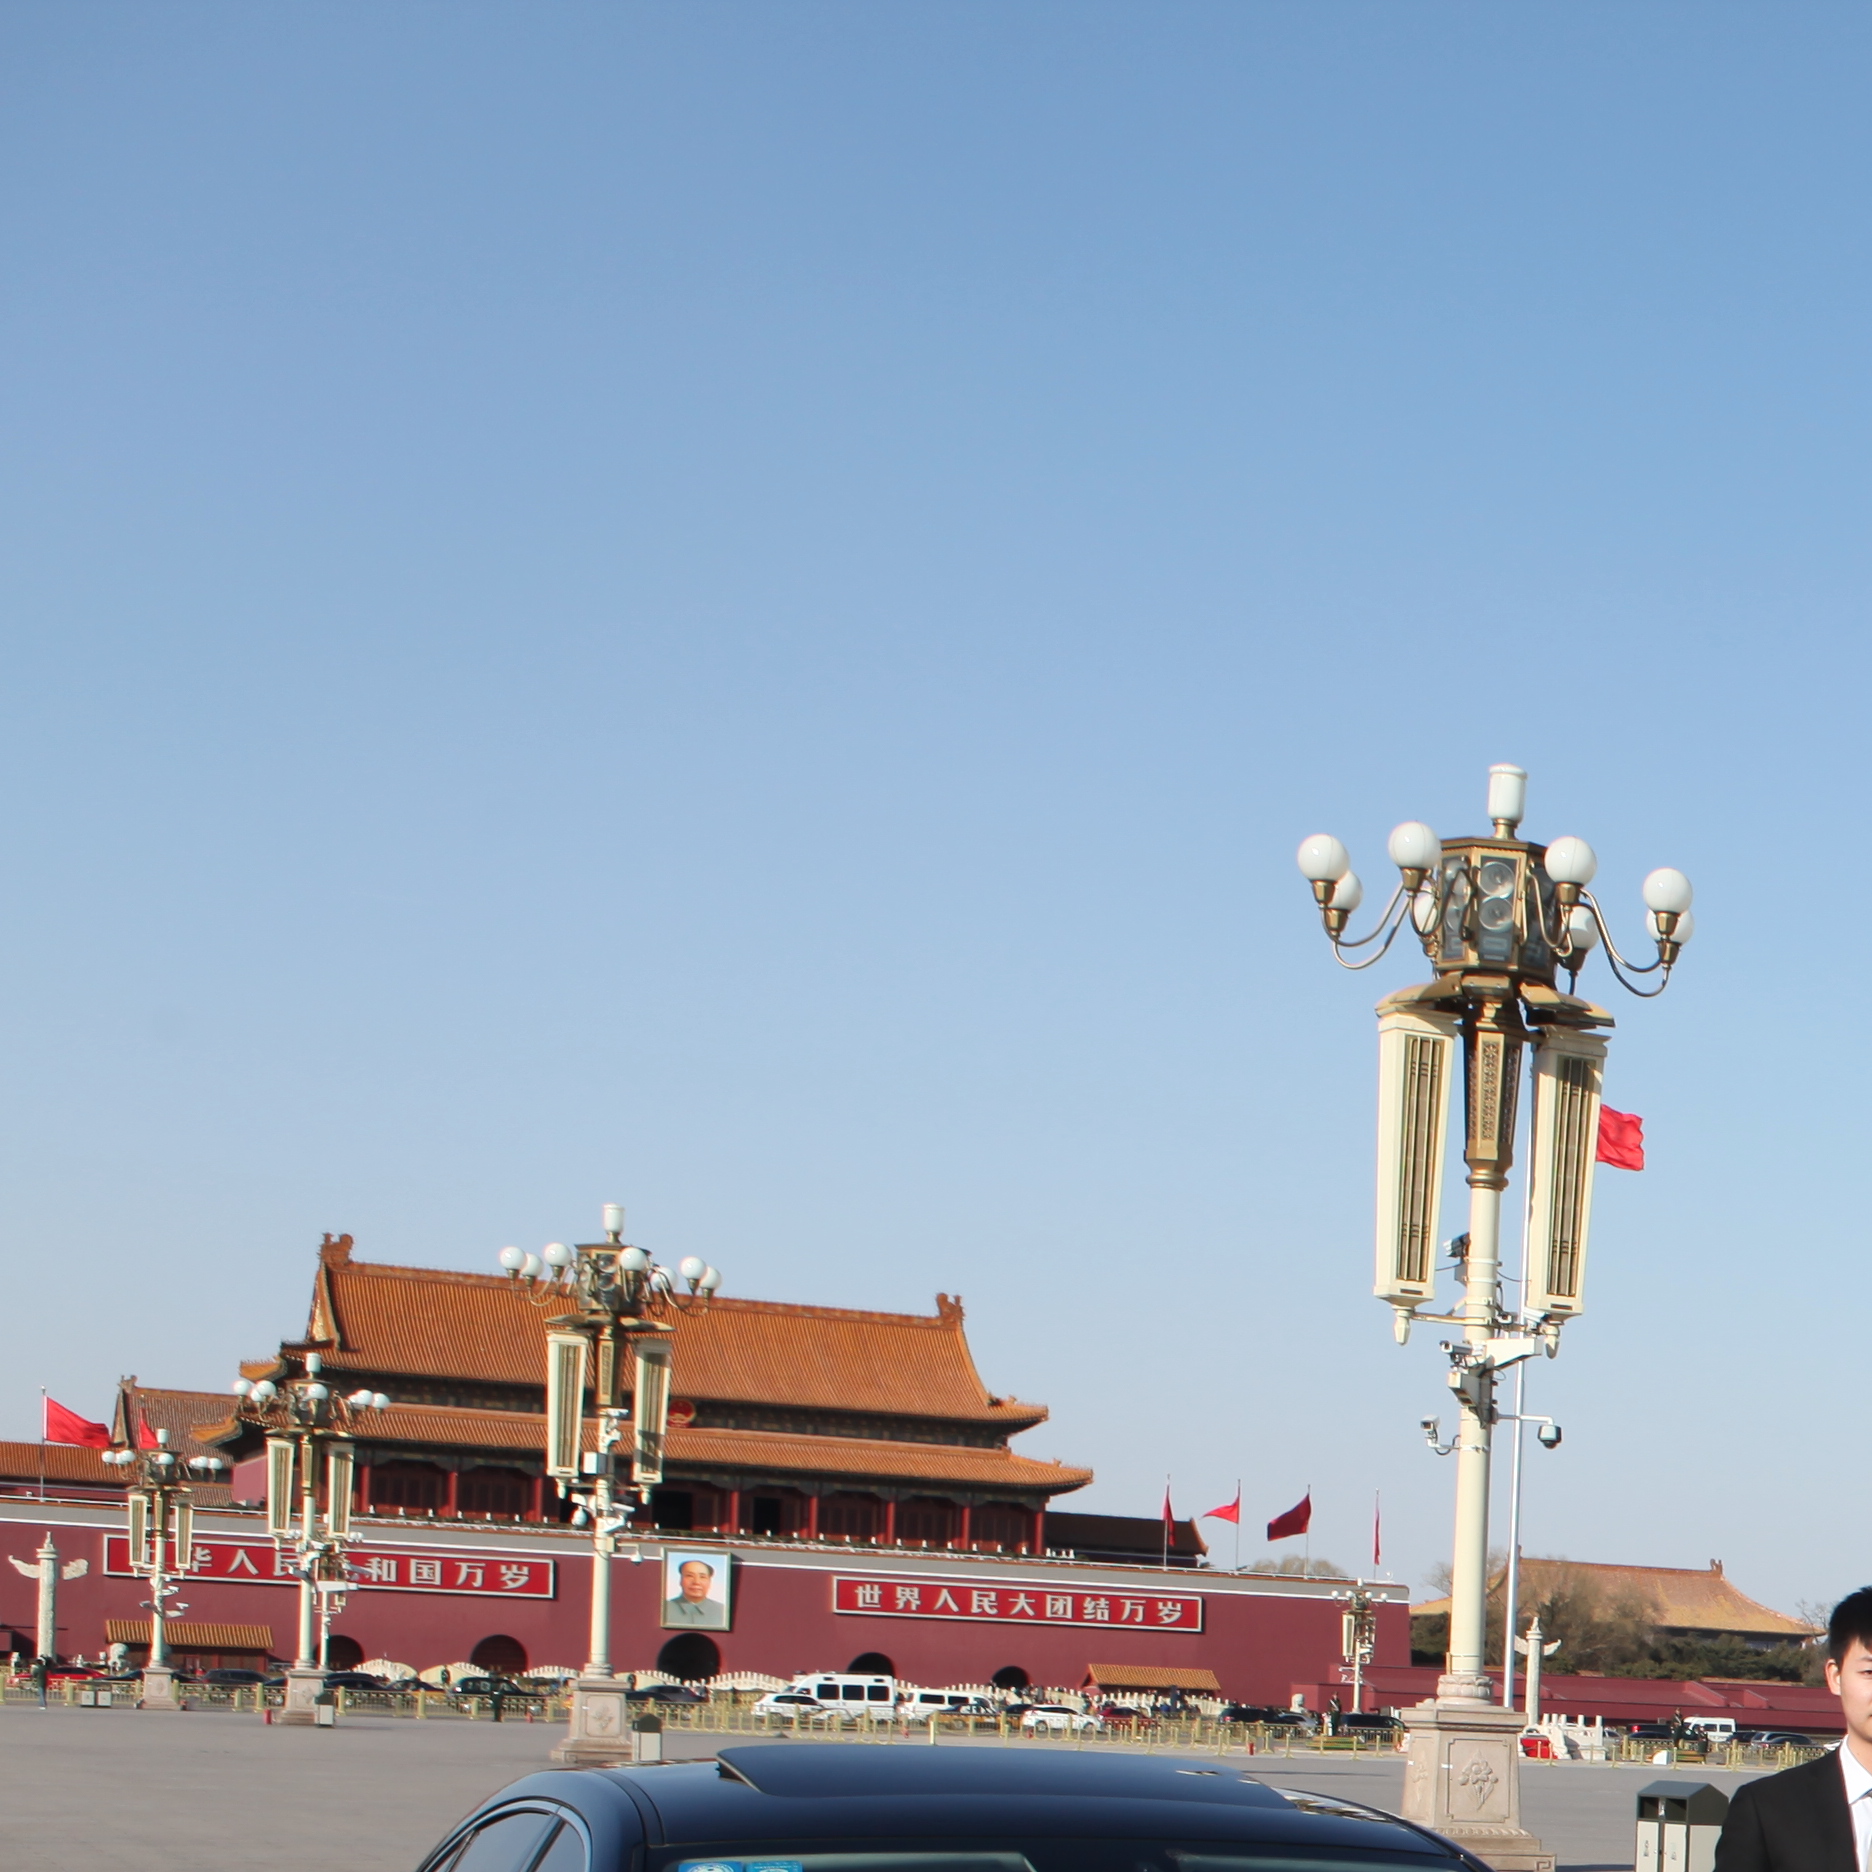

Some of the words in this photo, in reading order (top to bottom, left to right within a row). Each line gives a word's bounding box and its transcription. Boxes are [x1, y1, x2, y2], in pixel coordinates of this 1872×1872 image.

[143, 1543, 530, 1589] 华人民和国万岁
[855, 1584, 1182, 1624] 世界人民大团结万岁
